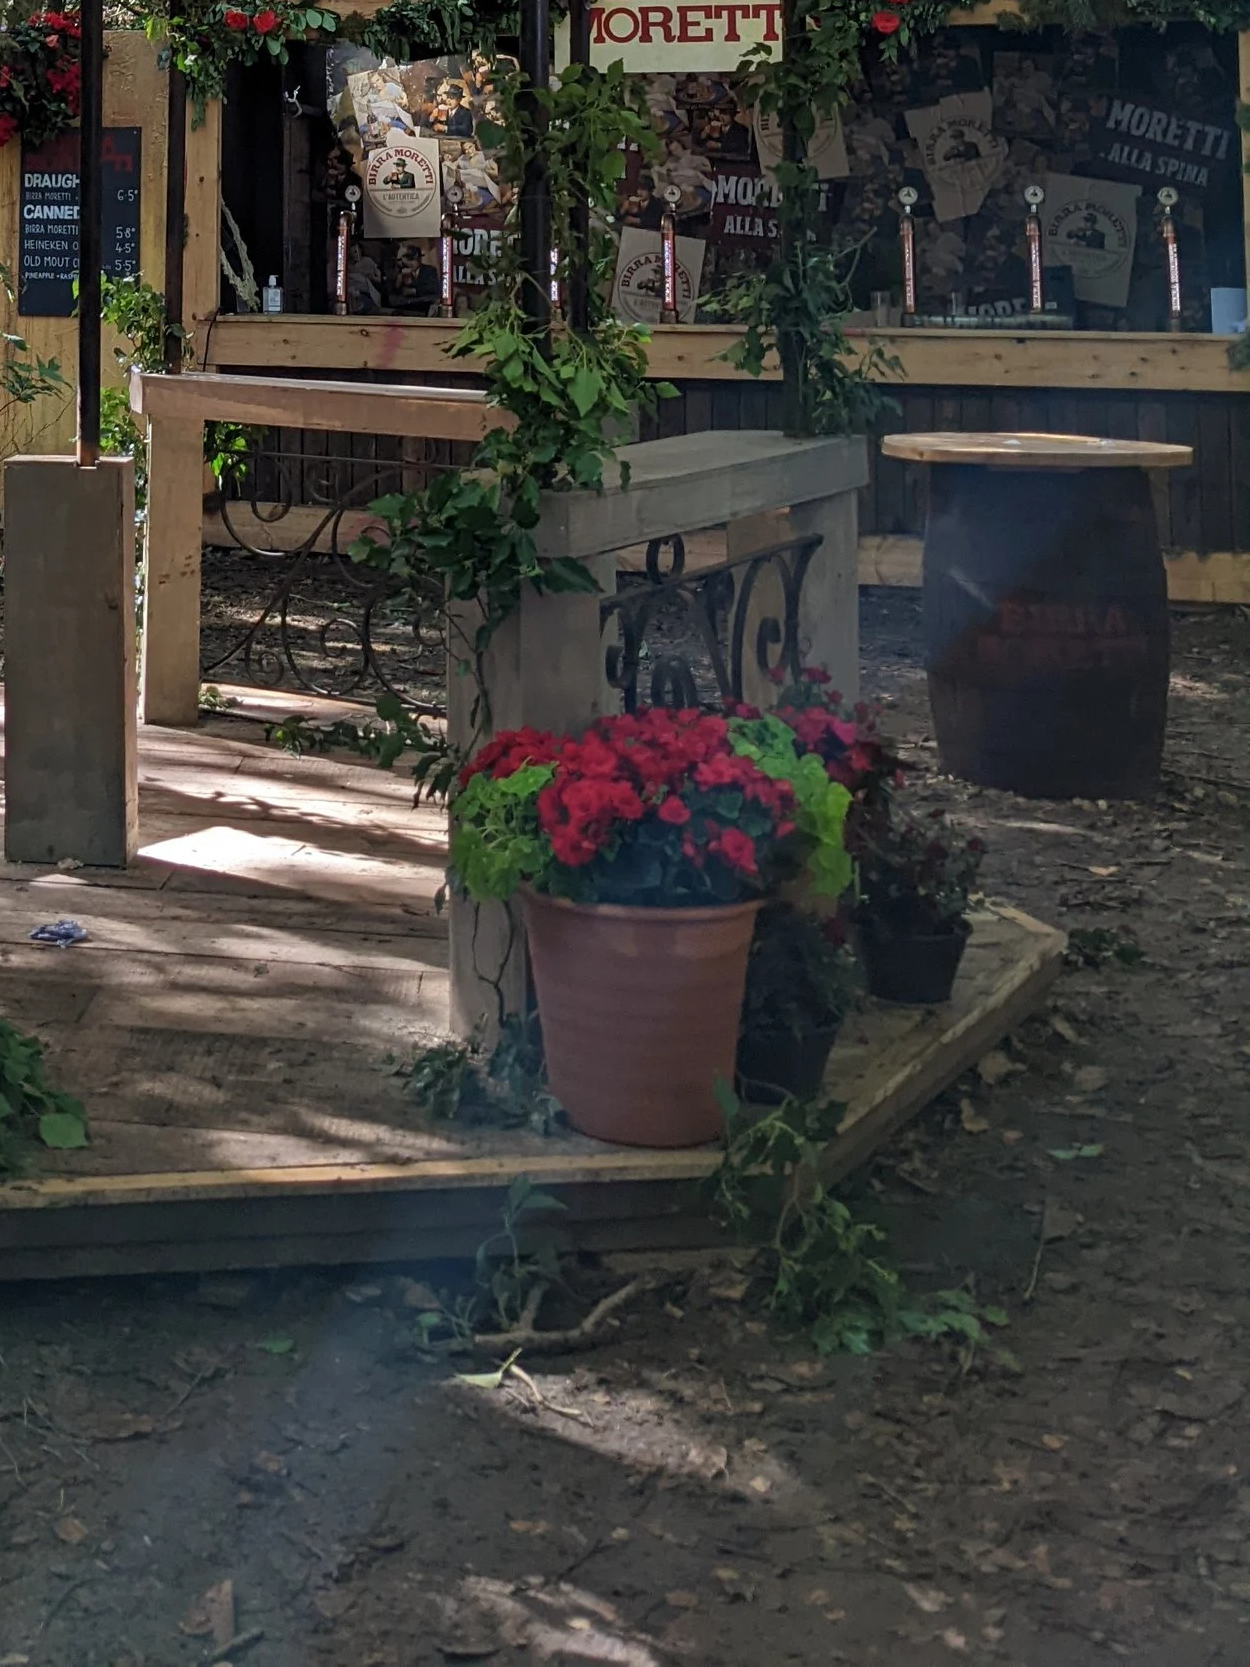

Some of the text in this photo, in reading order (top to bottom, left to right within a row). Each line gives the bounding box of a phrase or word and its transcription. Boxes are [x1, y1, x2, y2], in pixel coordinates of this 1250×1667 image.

[589, 4, 782, 43] ORETT
[1106, 99, 1230, 160] MORETTI
[369, 149, 434, 185] BIRRA MORETTI
[1108, 143, 1209, 187] ALLA SPINA
[24, 173, 80, 188] DRAUGH
[25, 224, 45, 234] BIRRA
[47, 224, 79, 235] MORETTI
[723, 215, 764, 237] ALLA
[24, 239, 69, 251] HEINEKEN
[23, 255, 41, 267] OLD
[44, 256, 70, 268] MOUT
[621, 256, 652, 287] BIRRA
